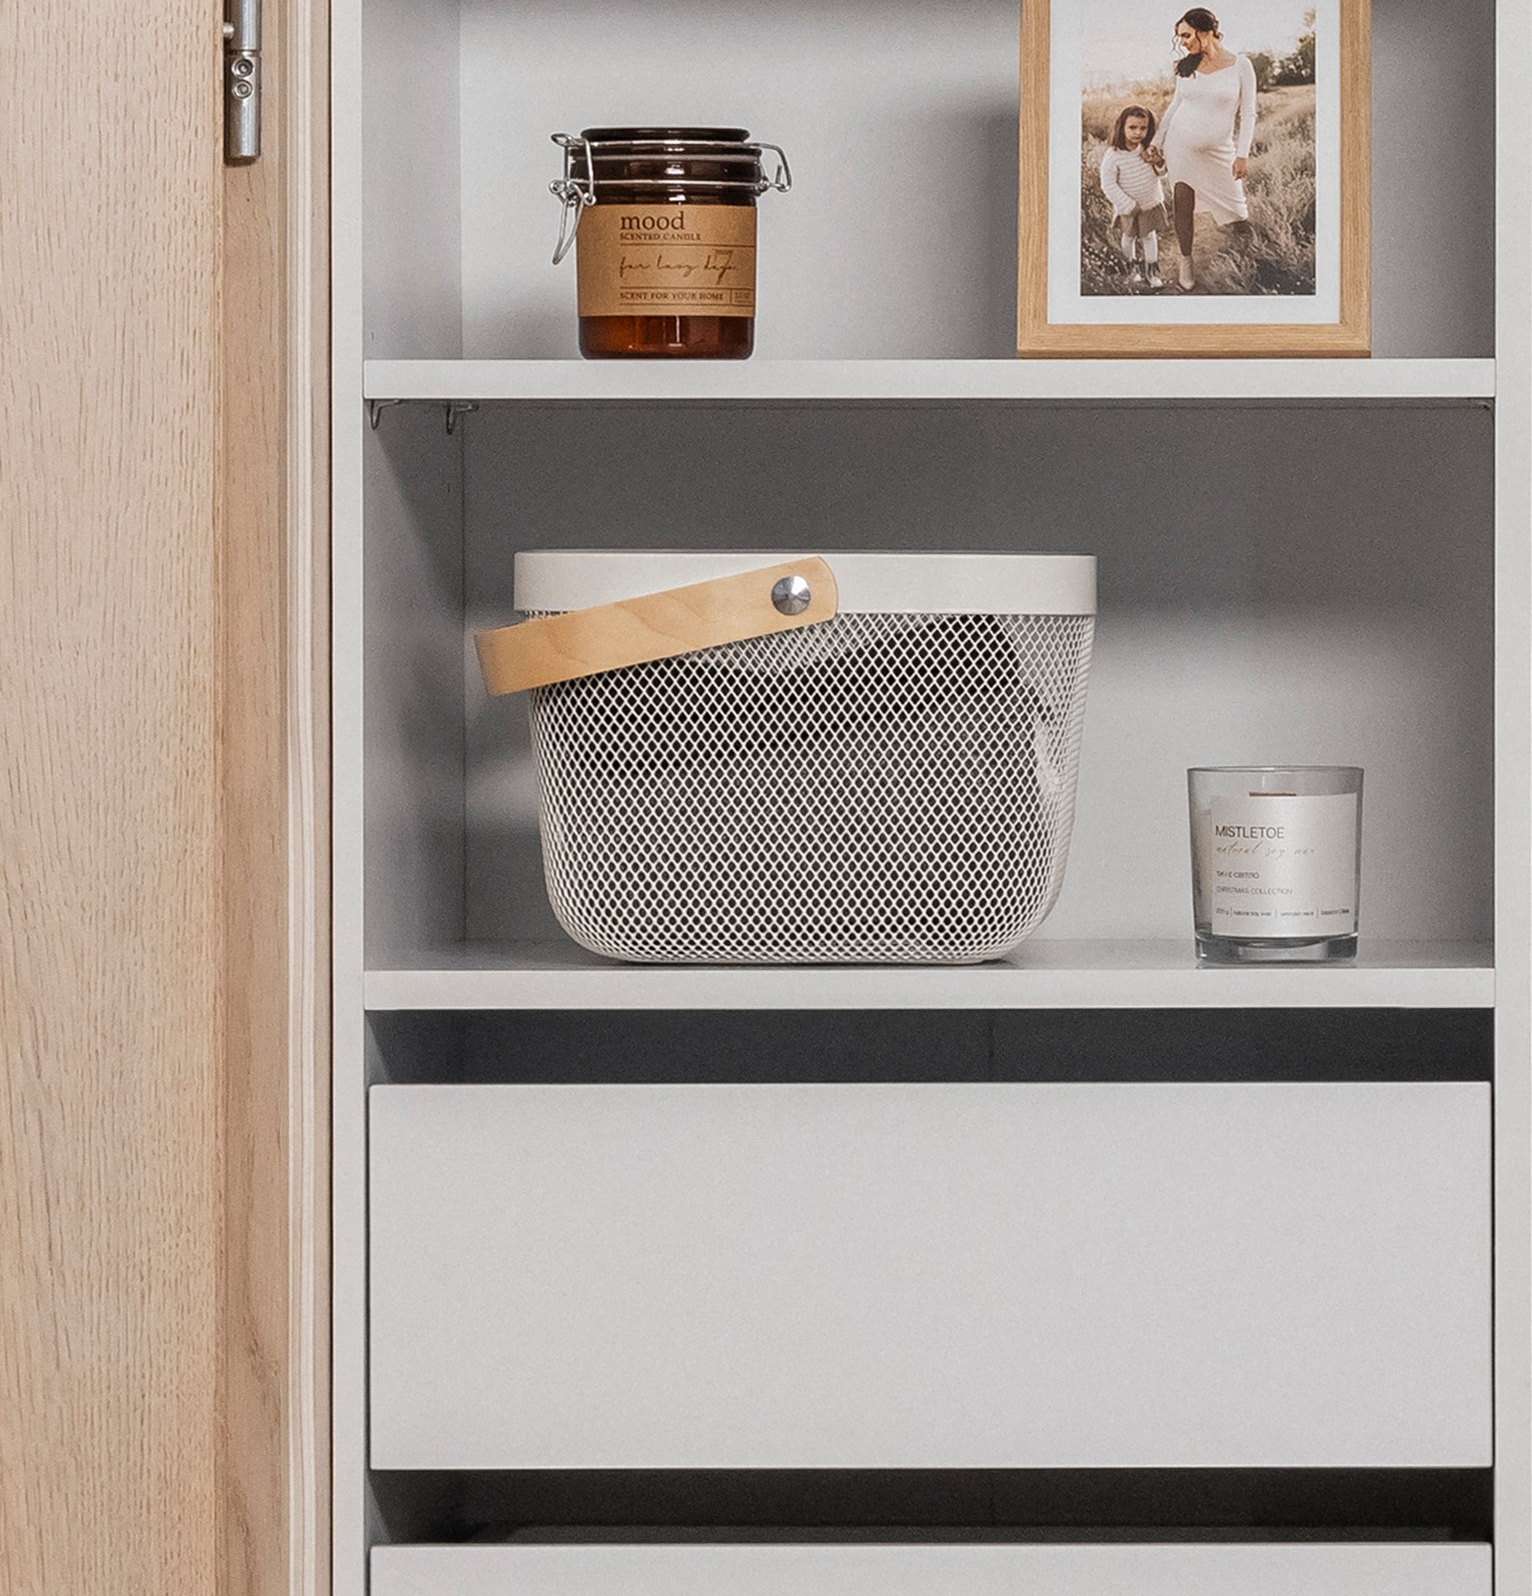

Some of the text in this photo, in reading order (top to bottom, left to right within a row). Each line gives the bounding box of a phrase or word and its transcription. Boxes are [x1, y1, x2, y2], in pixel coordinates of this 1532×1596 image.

[620, 210, 685, 231] mood
[620, 232, 660, 240] SCENTED
[620, 291, 648, 300] SCENT
[650, 291, 669, 300] FOR
[672, 291, 697, 300] YOUR
[1215, 825, 1285, 839] MISTLETOE
